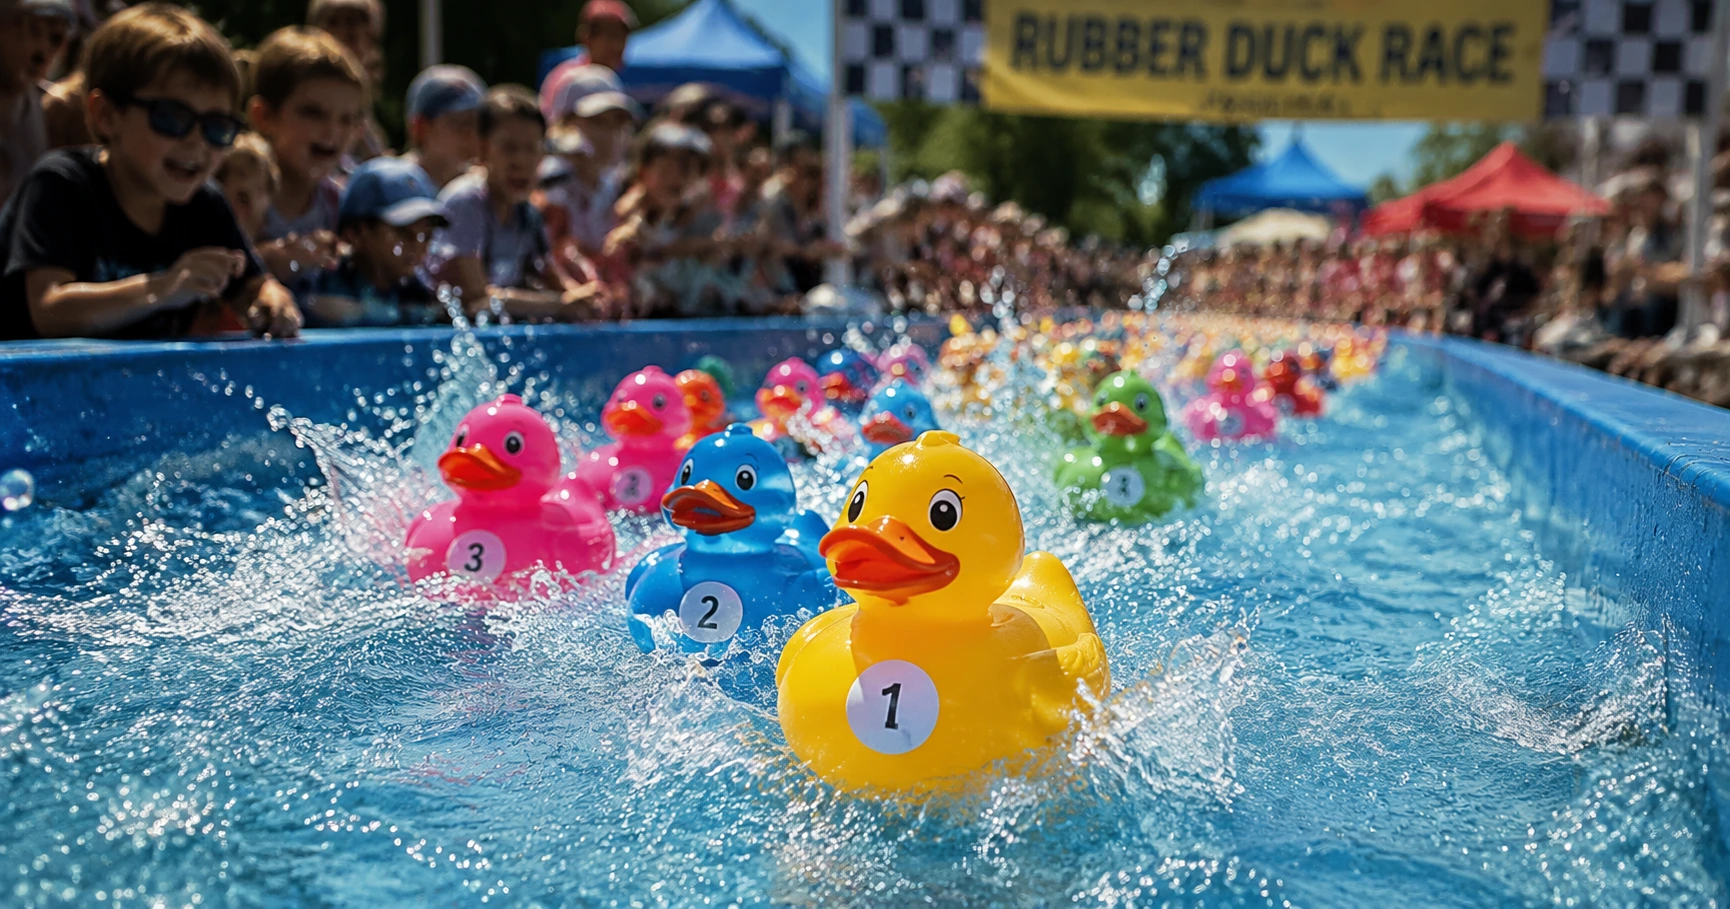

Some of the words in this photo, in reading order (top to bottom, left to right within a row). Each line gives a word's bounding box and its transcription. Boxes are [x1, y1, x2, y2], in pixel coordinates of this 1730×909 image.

[1010, 10, 1208, 81] RUBBER
[1225, 19, 1366, 84] DUCK
[1380, 20, 1515, 86] RACE
[464, 542, 484, 572] 3
[697, 595, 719, 629] 2
[881, 682, 902, 730] 1
